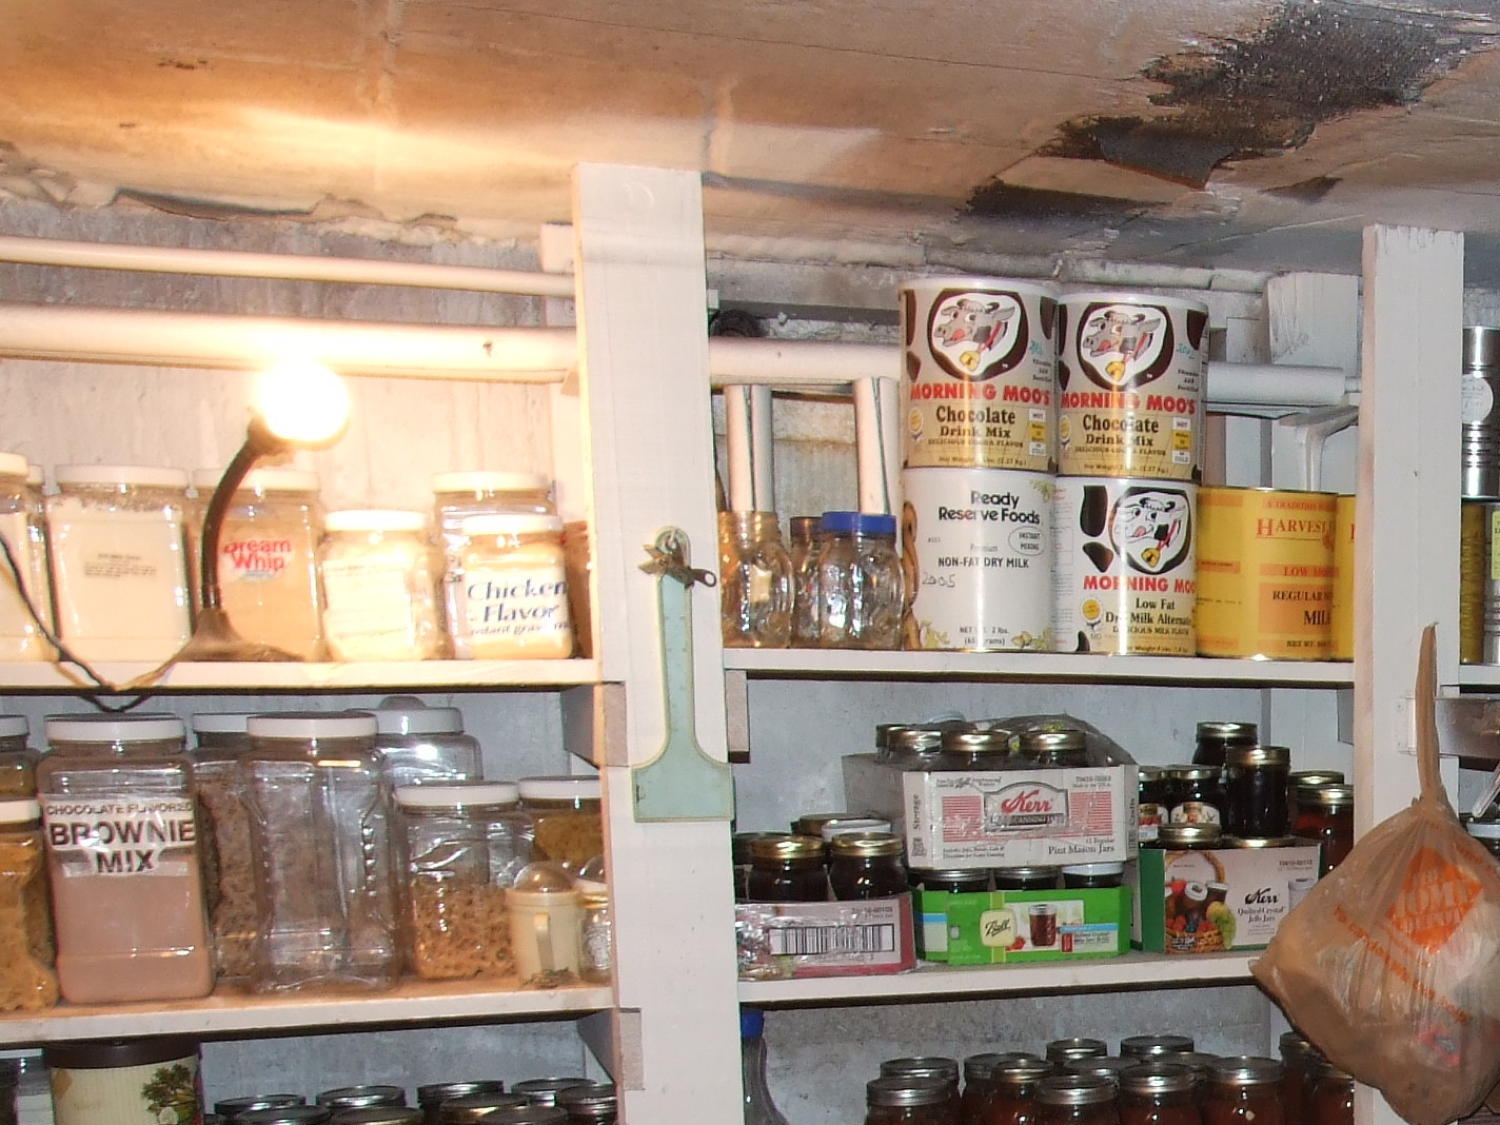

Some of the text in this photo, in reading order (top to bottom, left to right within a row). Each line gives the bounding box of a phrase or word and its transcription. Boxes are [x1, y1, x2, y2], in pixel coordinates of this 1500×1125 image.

[1145, 394, 1196, 415] MOO'S
[936, 405, 1016, 426] Chocolate
[1083, 414, 1159, 434] Chocolate
[940, 425, 1011, 439] Drink Mix
[1085, 433, 1124, 446] Drink
[970, 490, 1020, 510] Ready
[938, 506, 1040, 525] Reserve Foods
[232, 552, 285, 573] Whip
[938, 557, 1029, 569] NON-FAT DRY MILK
[467, 577, 568, 600] Chicken
[483, 602, 560, 622] Flavor
[1135, 598, 1175, 611] Low Fat
[1130, 611, 1154, 625] Milk
[47, 803, 125, 815] CHOCOLATE
[1001, 789, 1052, 814] Kerr
[50, 819, 196, 846] BROWNIE
[97, 850, 154, 873] MIX
[1245, 888, 1279, 904] Kerr
[985, 919, 1010, 937] Ball
